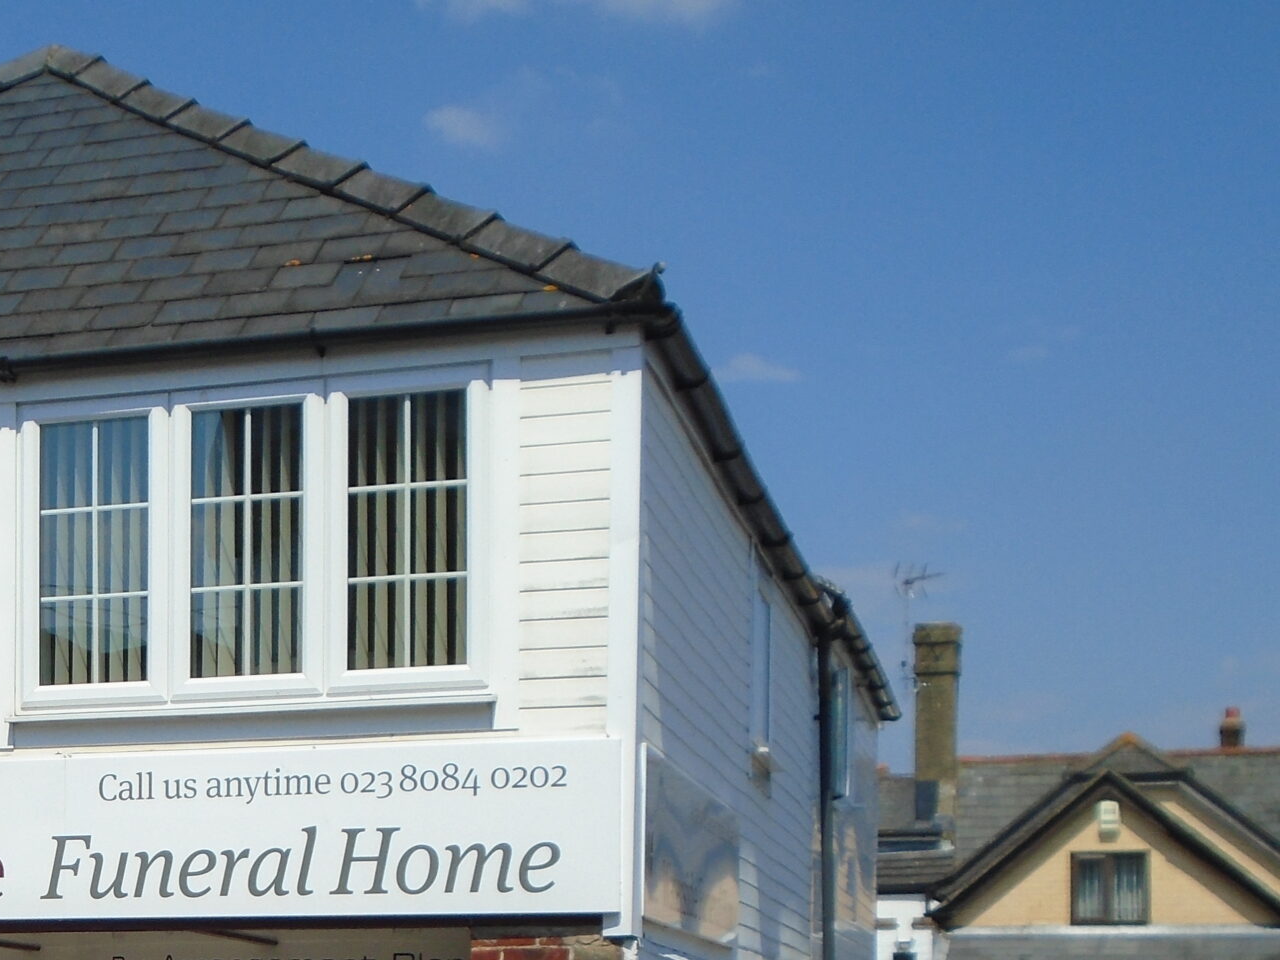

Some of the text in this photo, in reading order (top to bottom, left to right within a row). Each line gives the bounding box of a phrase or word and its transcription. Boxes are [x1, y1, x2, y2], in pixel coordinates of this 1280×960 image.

[98, 762, 569, 805] Call us anytime 023 8084 0202
[39, 824, 318, 900] Funeral
[328, 826, 562, 896] Home
